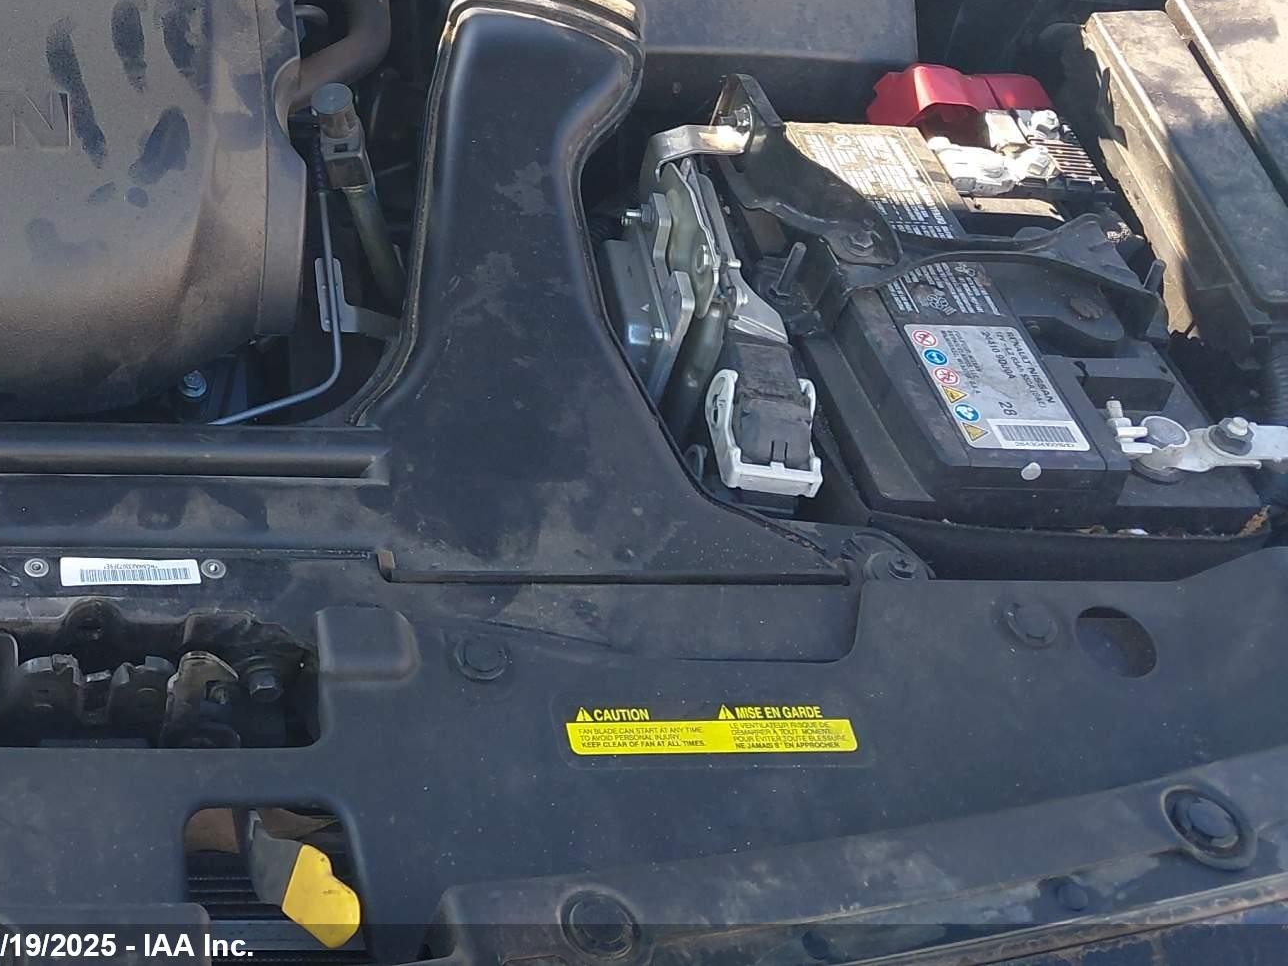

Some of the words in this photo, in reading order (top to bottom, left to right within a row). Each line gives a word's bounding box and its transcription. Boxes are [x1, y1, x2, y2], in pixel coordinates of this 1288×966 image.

[1006, 331, 1032, 365] RENAULT
[1027, 367, 1056, 404] NISSAN
[998, 401, 1018, 416] 28
[593, 708, 650, 722] CAUTION
[734, 706, 764, 719] MISE
[764, 706, 781, 719] EN
[782, 705, 823, 718] GARDE
